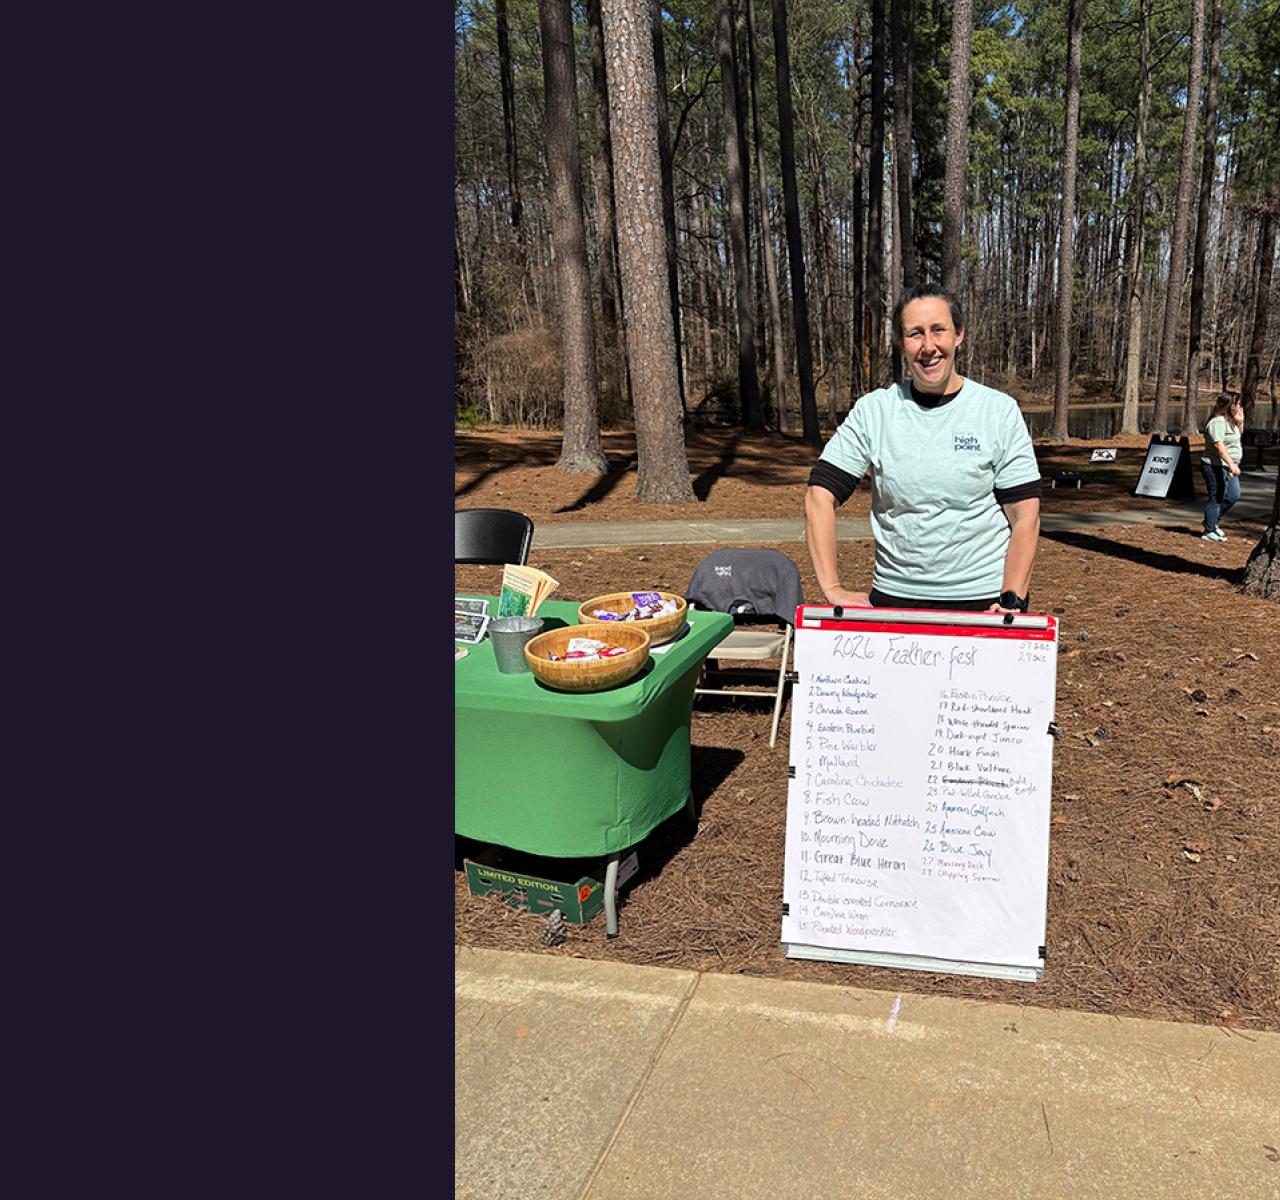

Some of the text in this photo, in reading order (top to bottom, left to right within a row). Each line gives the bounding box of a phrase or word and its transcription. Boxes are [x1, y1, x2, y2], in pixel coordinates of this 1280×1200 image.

[954, 436, 978, 445] high
[954, 444, 981, 452] point
[1148, 466, 1168, 475] ZONE
[833, 634, 875, 659] 2026
[991, 733, 1023, 744] Junco
[815, 791, 841, 806] Fish
[858, 830, 889, 848] Dove
[813, 850, 843, 864] Great
[849, 853, 872, 868] Blue
[877, 857, 906, 871] Heron
[939, 840, 963, 853] Blue
[967, 842, 993, 867] Jay
[477, 868, 515, 884] LIMITED
